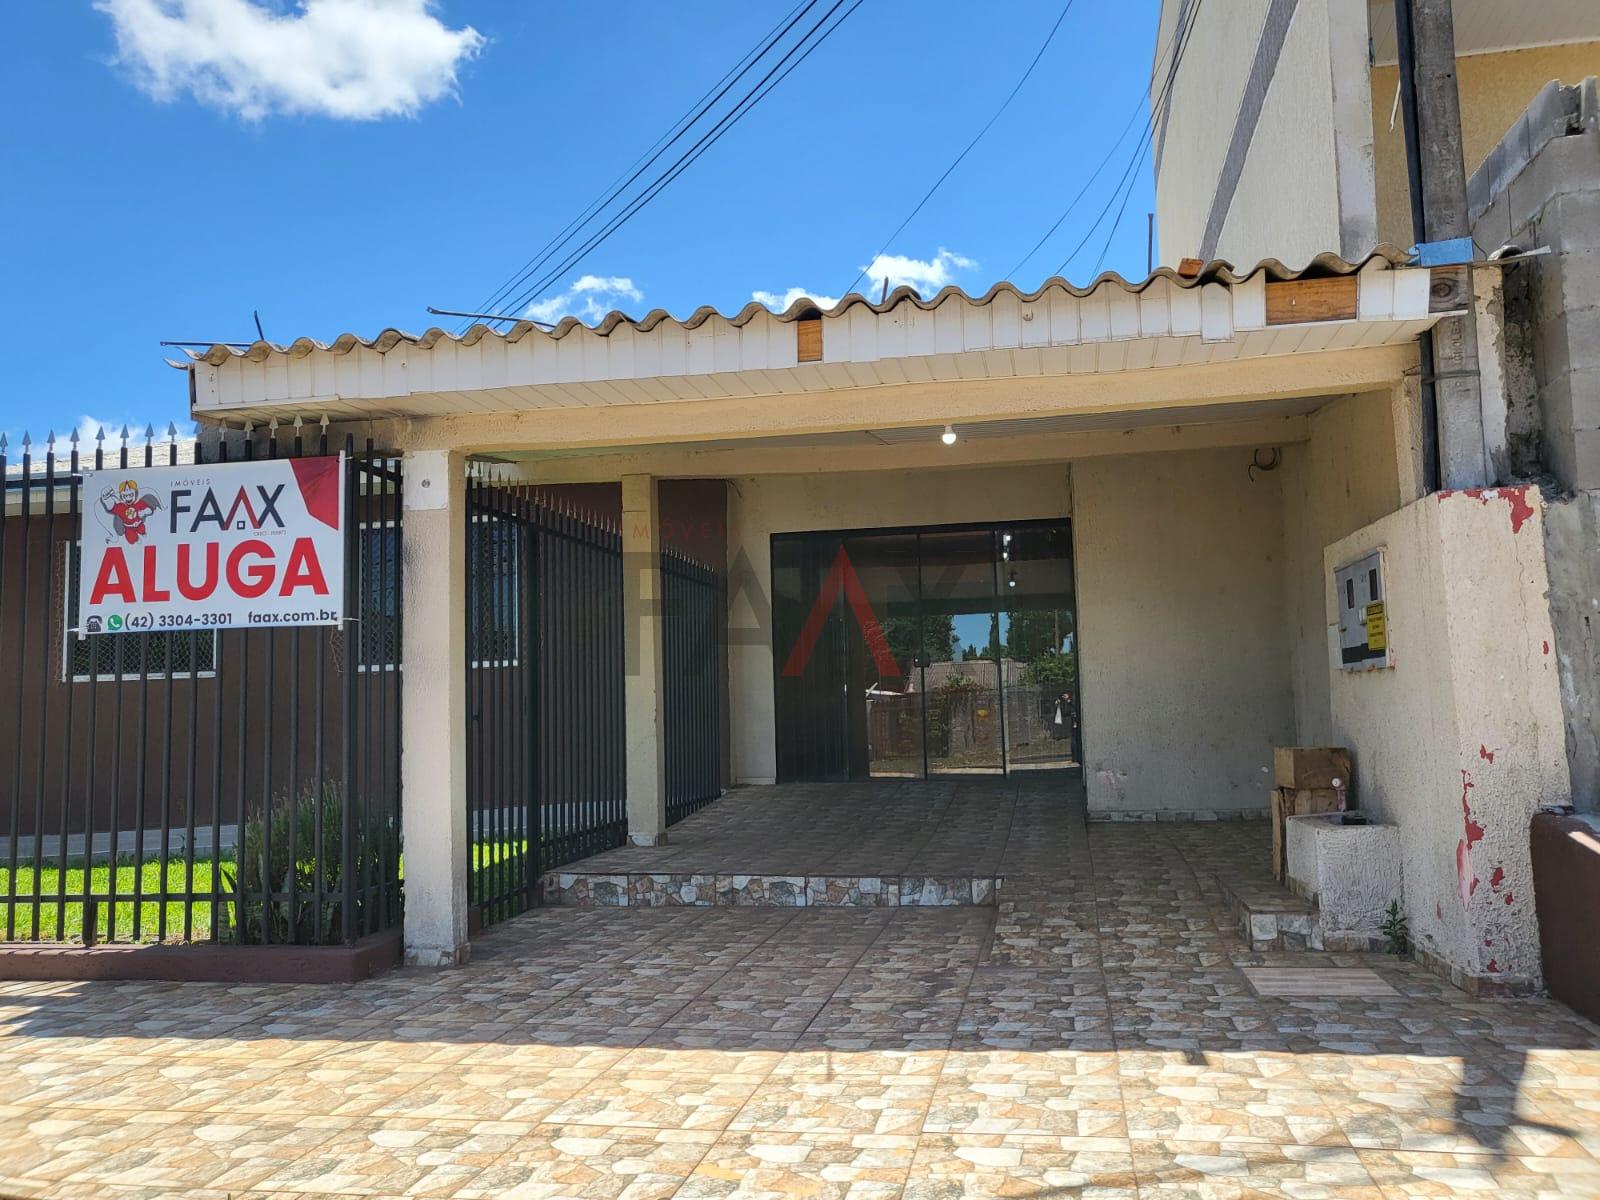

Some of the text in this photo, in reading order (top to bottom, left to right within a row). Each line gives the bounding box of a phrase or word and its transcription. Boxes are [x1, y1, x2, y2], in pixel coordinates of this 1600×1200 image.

[170, 478, 211, 488] IMÓVEIS
[169, 484, 286, 534] FAAX
[89, 537, 330, 605] ALUGA
[125, 609, 337, 629] (42) 3304-3301 faax.com.br
